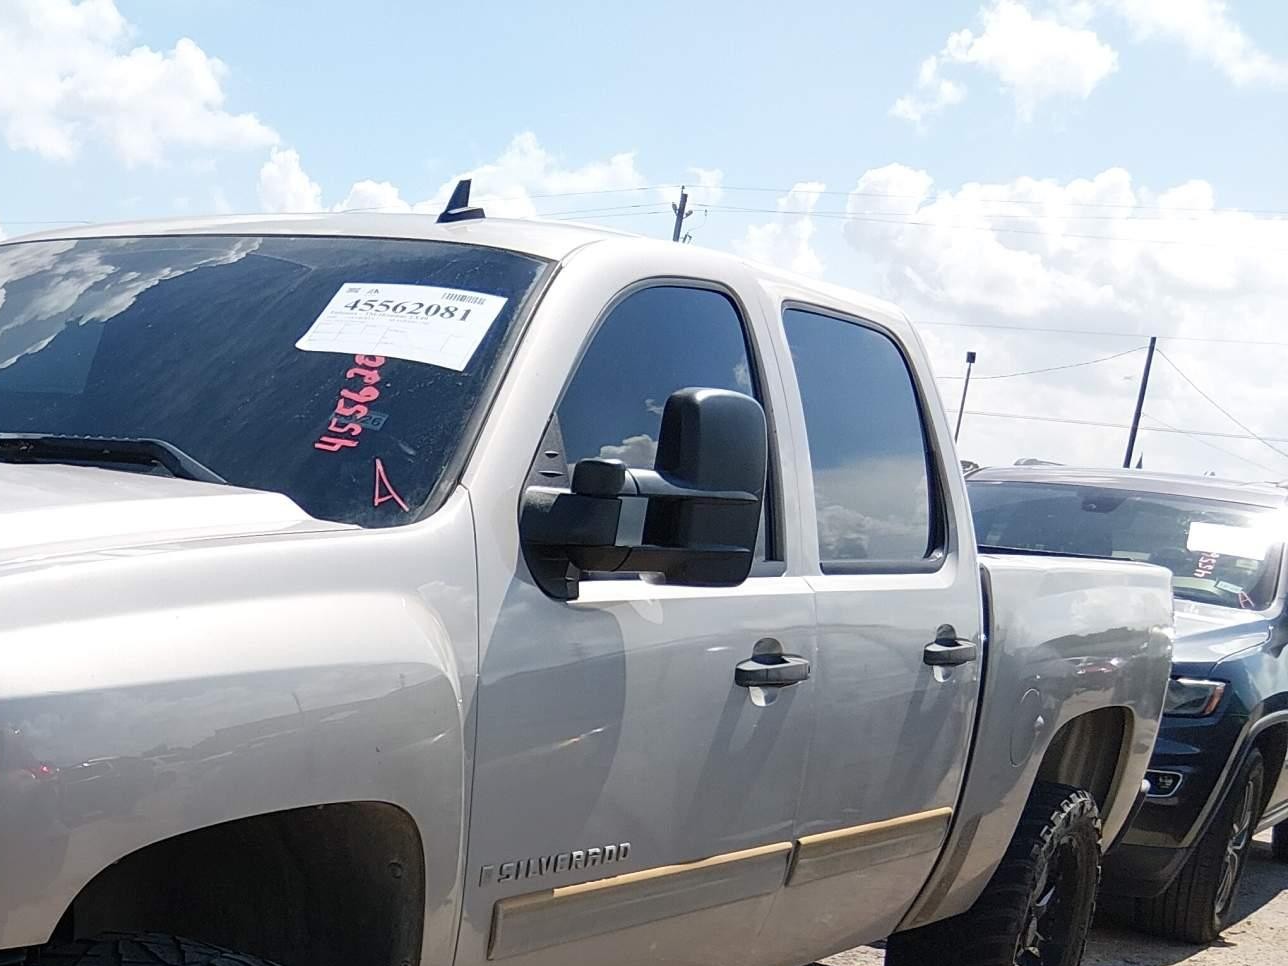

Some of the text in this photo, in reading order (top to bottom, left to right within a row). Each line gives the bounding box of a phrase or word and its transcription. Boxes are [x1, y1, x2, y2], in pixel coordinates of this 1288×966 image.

[343, 298, 472, 322] 45562081
[374, 458, 409, 512] A
[496, 842, 632, 883] SILVERADO
